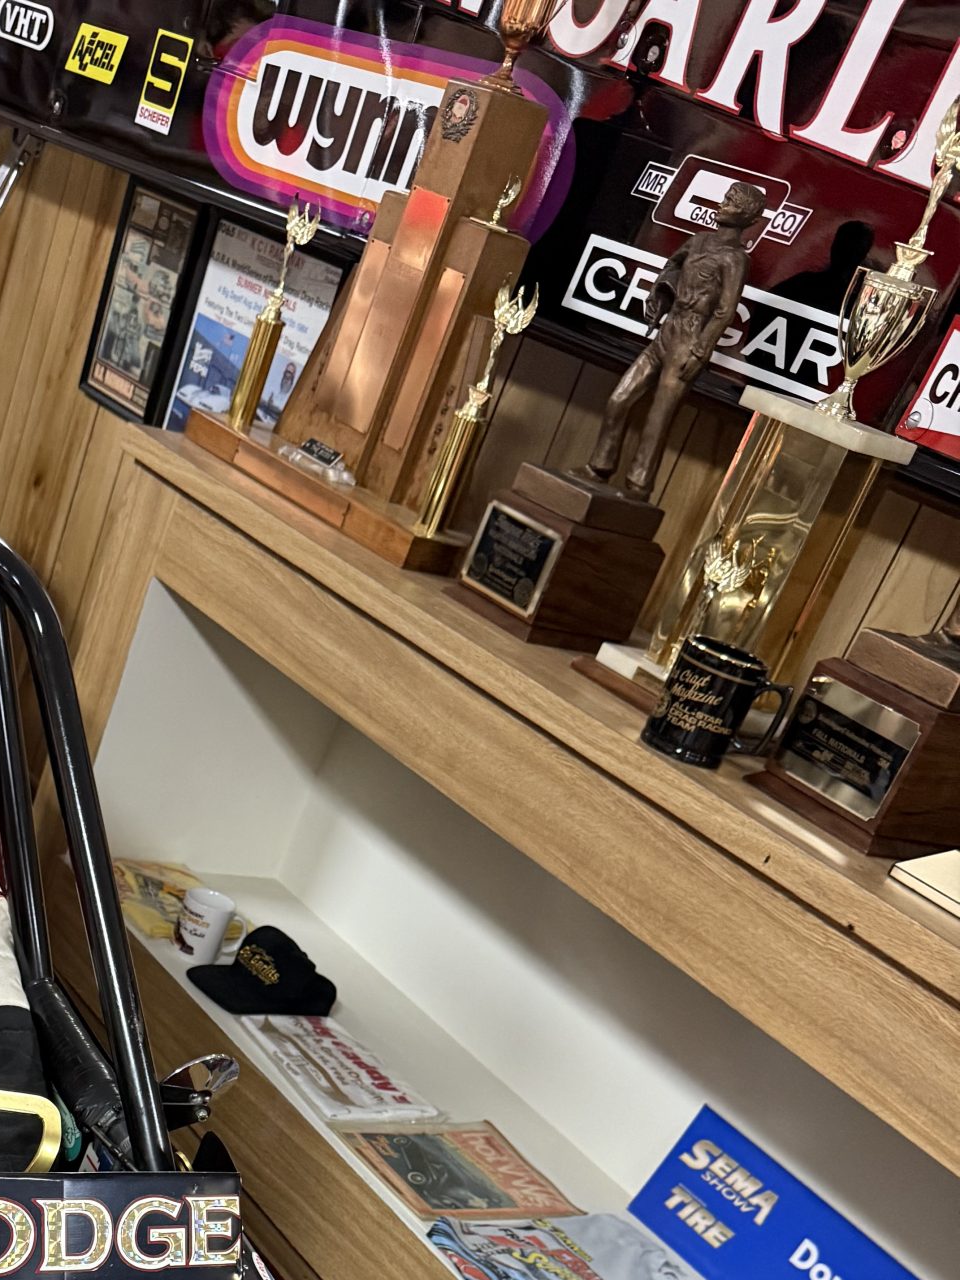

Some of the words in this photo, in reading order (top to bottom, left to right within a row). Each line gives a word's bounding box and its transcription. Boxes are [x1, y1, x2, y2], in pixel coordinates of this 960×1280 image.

[5, 2, 46, 42] VHT
[71, 32, 118, 72] ACCEL
[641, 169, 666, 194] MR.
[771, 209, 798, 234] CO.
[584, 258, 842, 386] CRGAR
[680, 669, 712, 690] Craft
[672, 683, 724, 705] Magazine
[666, 713, 697, 733] TEAM
[669, 707, 698, 724] DRAG
[697, 720, 732, 735] RACING
[672, 701, 723, 725] ALL-STAR
[679, 1138, 780, 1227] SEMA
[700, 1170, 755, 1213] SHOW
[663, 1183, 735, 1249] TIRE
